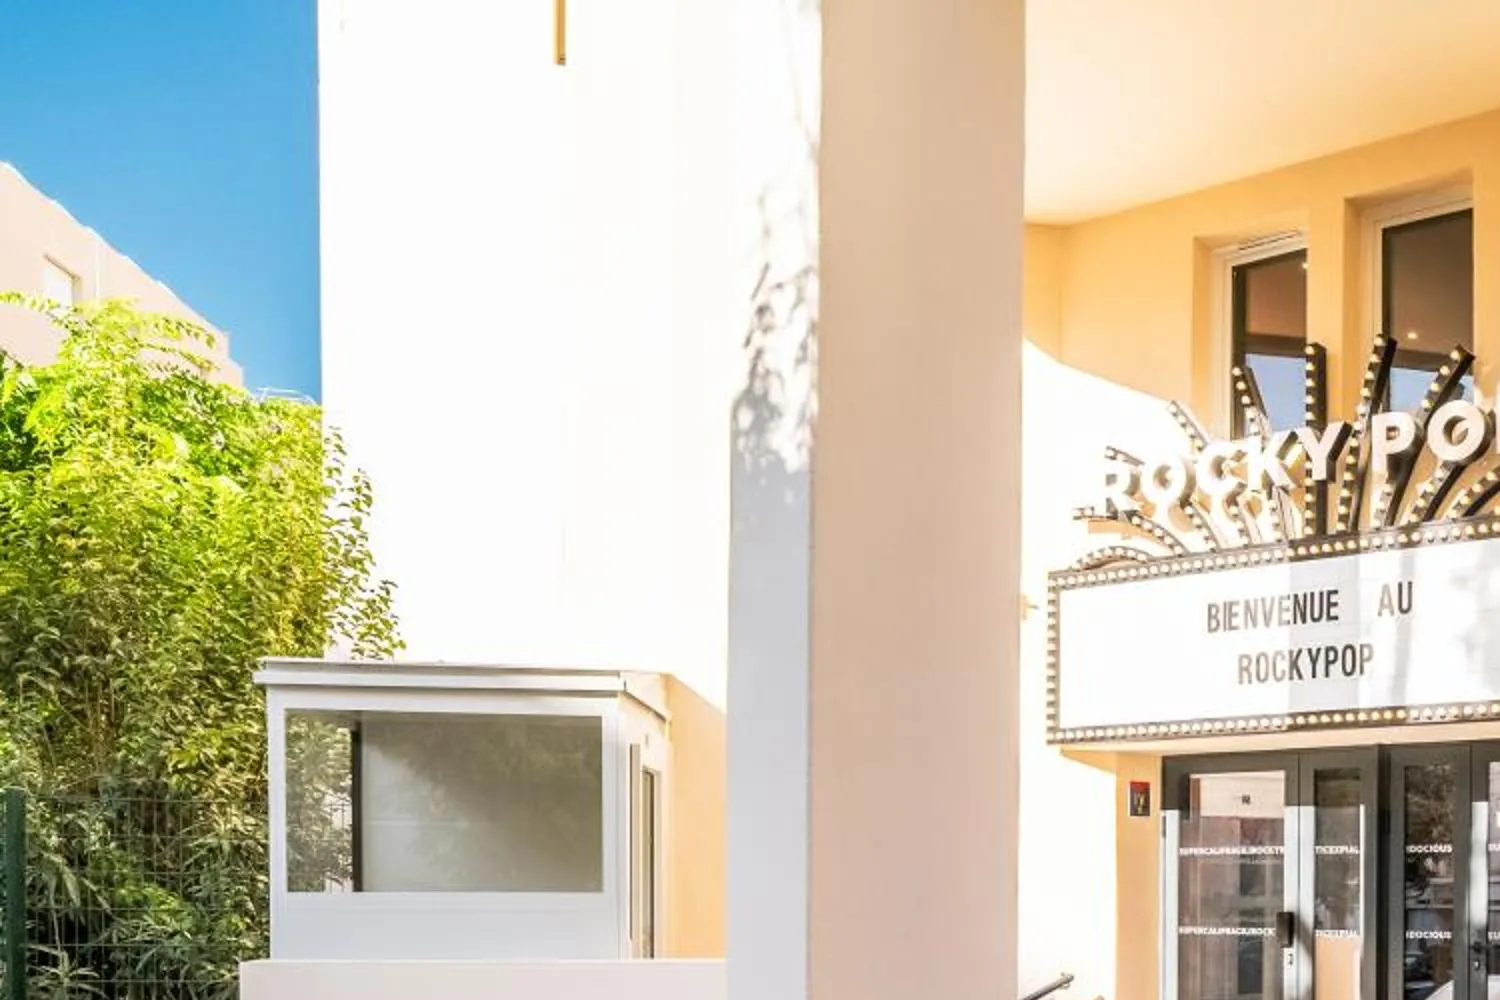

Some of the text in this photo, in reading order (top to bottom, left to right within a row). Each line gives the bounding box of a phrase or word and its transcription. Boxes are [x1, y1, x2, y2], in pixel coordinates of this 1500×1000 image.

[1098, 420, 1352, 511] ROCKY
[1206, 581, 1414, 634] BIENVENUE AU
[1237, 643, 1374, 685] ROCKYPOP
